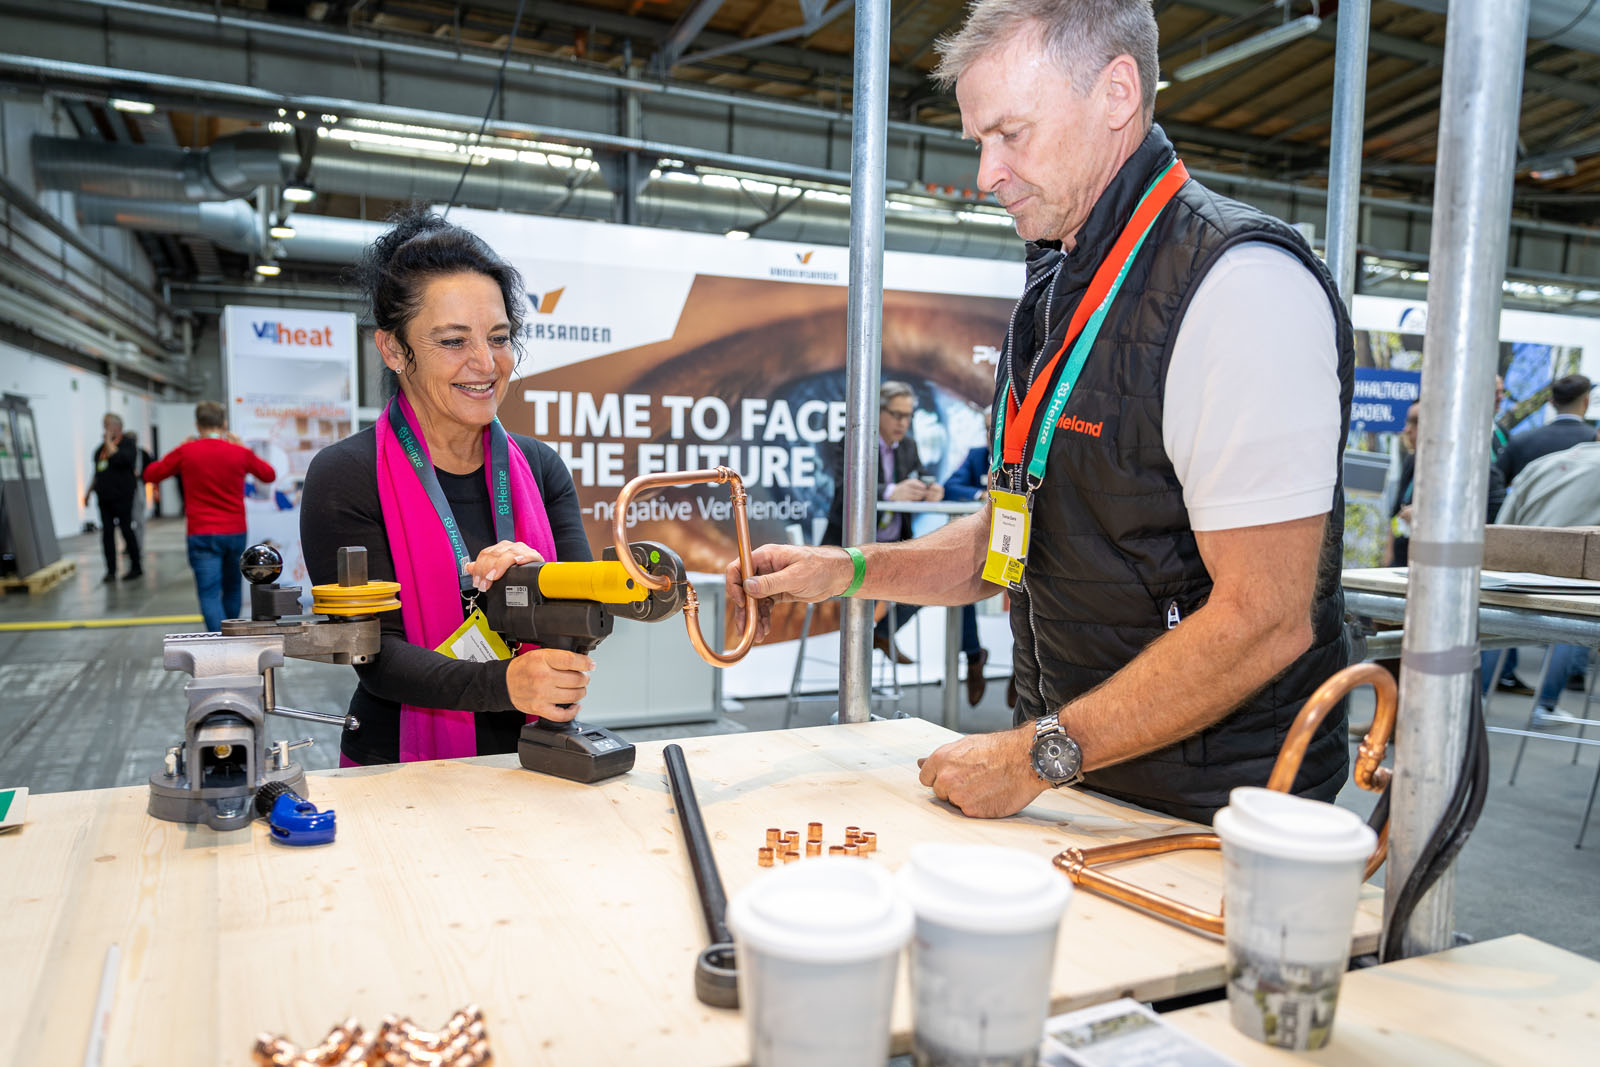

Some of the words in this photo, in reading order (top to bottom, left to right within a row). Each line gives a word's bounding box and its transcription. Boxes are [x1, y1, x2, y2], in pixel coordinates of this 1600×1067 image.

[523, 389, 652, 438] TIME
[662, 395, 731, 441] TO
[1039, 399, 1063, 445] Heinze
[403, 435, 424, 468] Heinze
[637, 443, 817, 488] FUTURE
[497, 470, 508, 501] Heinze
[696, 494, 812, 521] Verlender
